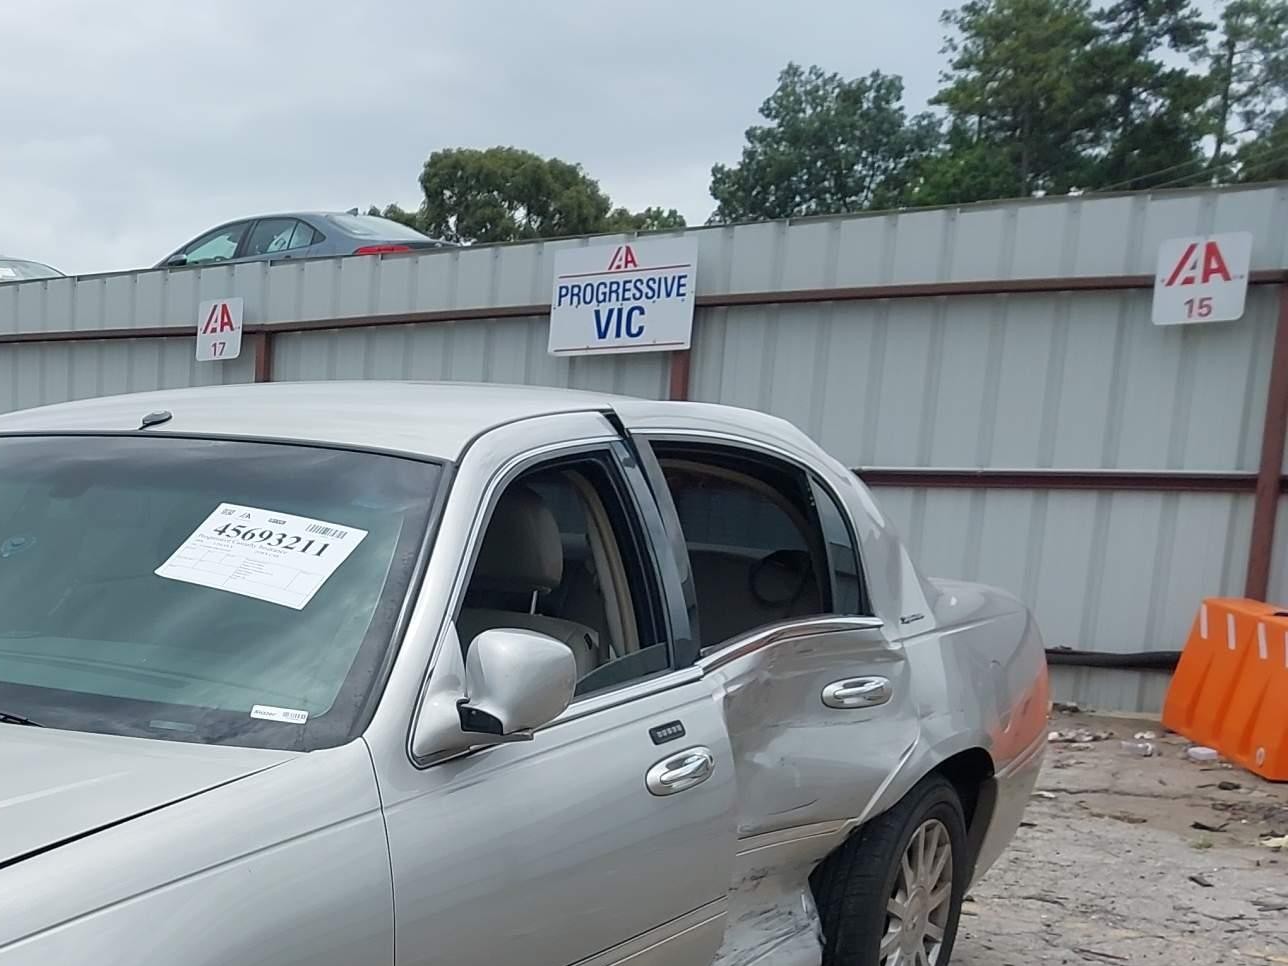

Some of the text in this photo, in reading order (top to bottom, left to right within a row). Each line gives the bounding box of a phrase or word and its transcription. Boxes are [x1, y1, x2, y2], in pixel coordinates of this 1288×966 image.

[558, 274, 688, 307] PROGRESSIVE
[594, 305, 645, 340] VIC
[1184, 297, 1213, 319] 15
[212, 341, 226, 357] 17
[213, 521, 331, 557] 45693211
